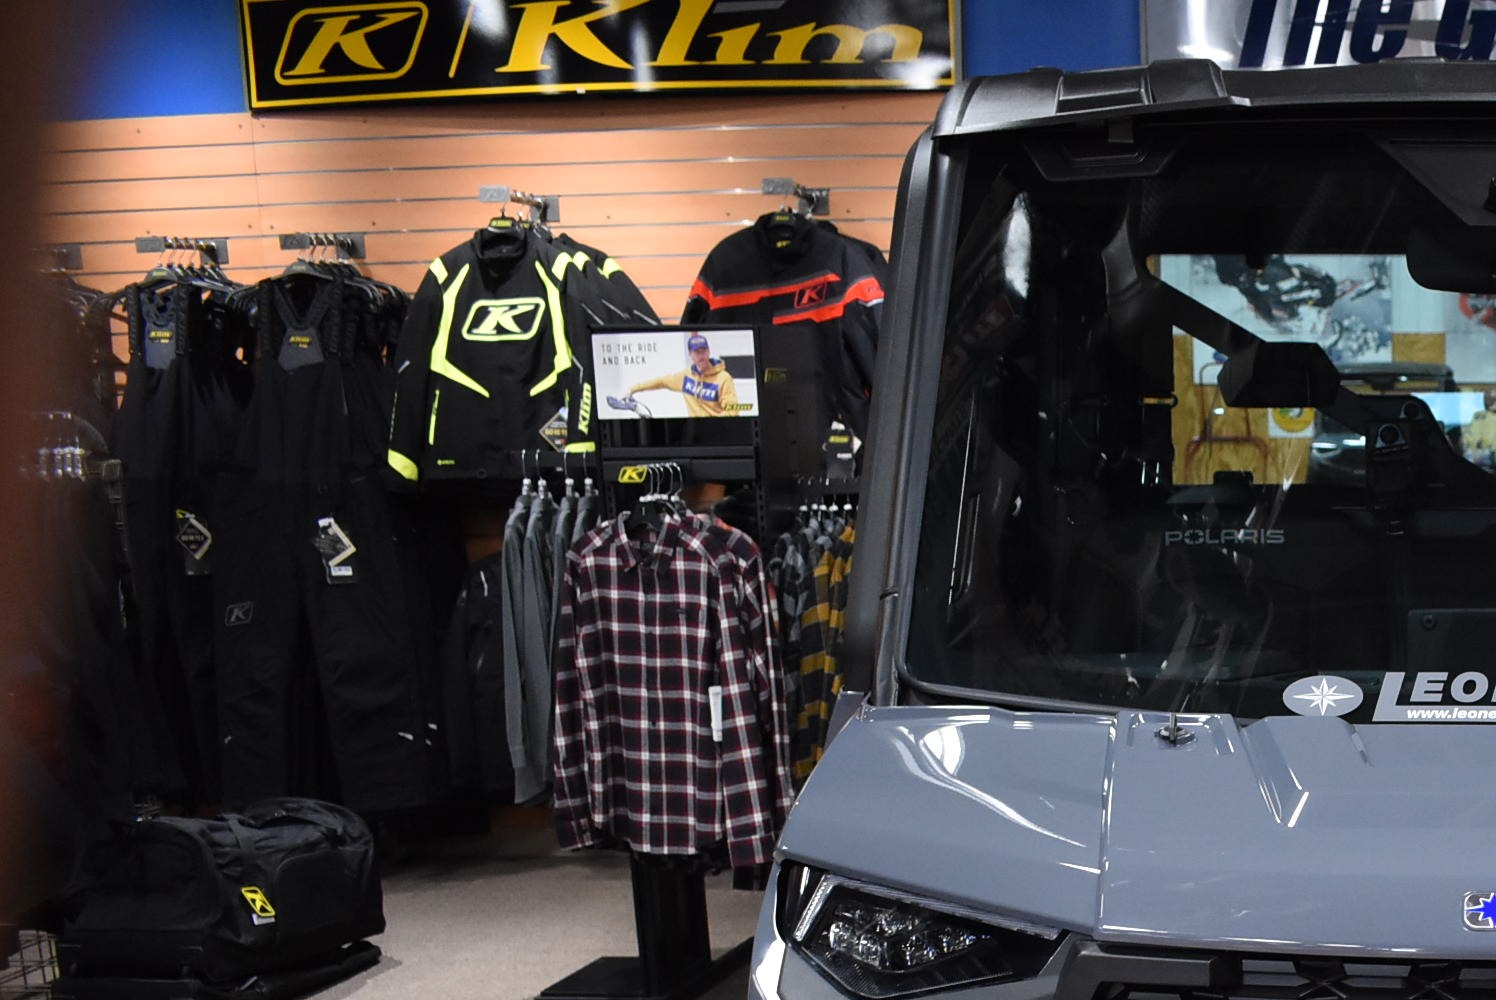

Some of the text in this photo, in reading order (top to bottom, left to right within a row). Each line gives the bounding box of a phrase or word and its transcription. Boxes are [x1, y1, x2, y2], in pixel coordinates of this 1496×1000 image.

[601, 342, 657, 353] TO THE RIDE
[602, 355, 647, 365] AND BACK
[1164, 528, 1286, 546] POLARIS
